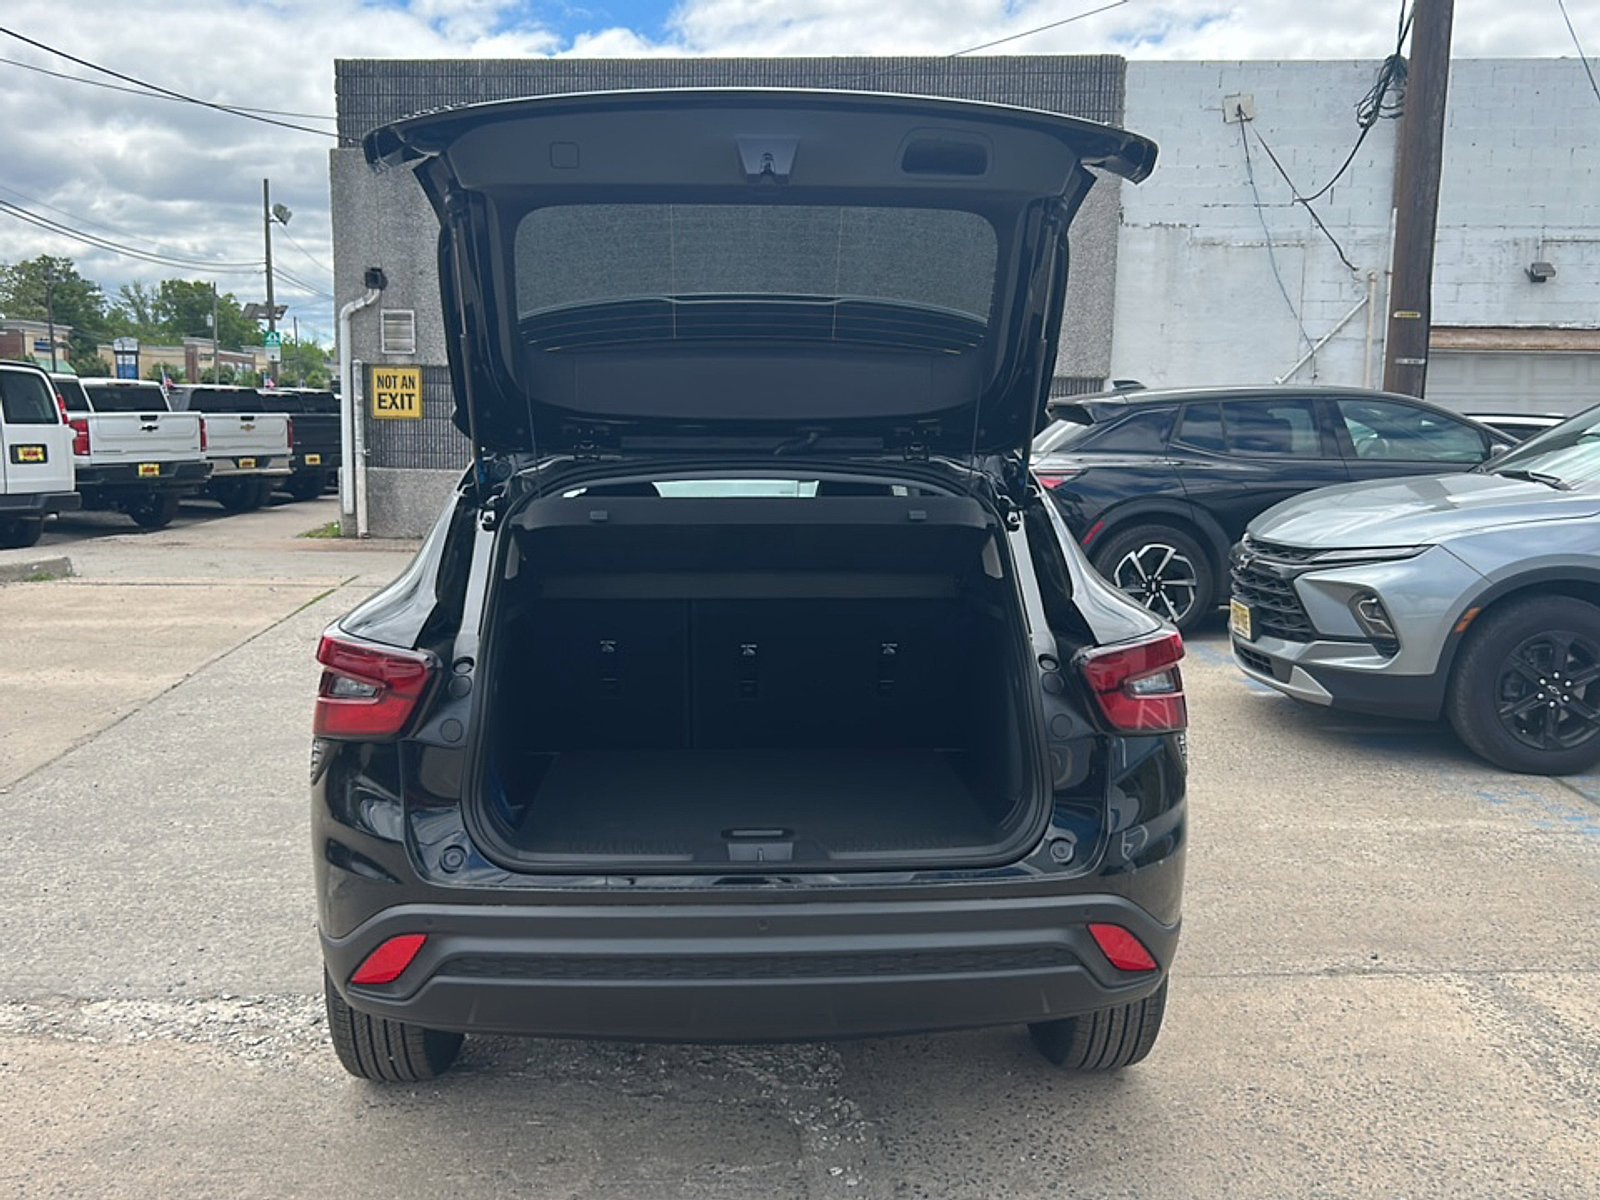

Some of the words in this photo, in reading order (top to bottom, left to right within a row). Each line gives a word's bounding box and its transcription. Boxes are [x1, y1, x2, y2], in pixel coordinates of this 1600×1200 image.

[376, 375, 398, 389] NOT
[400, 375, 416, 389] AN
[377, 393, 415, 410] EXIT
